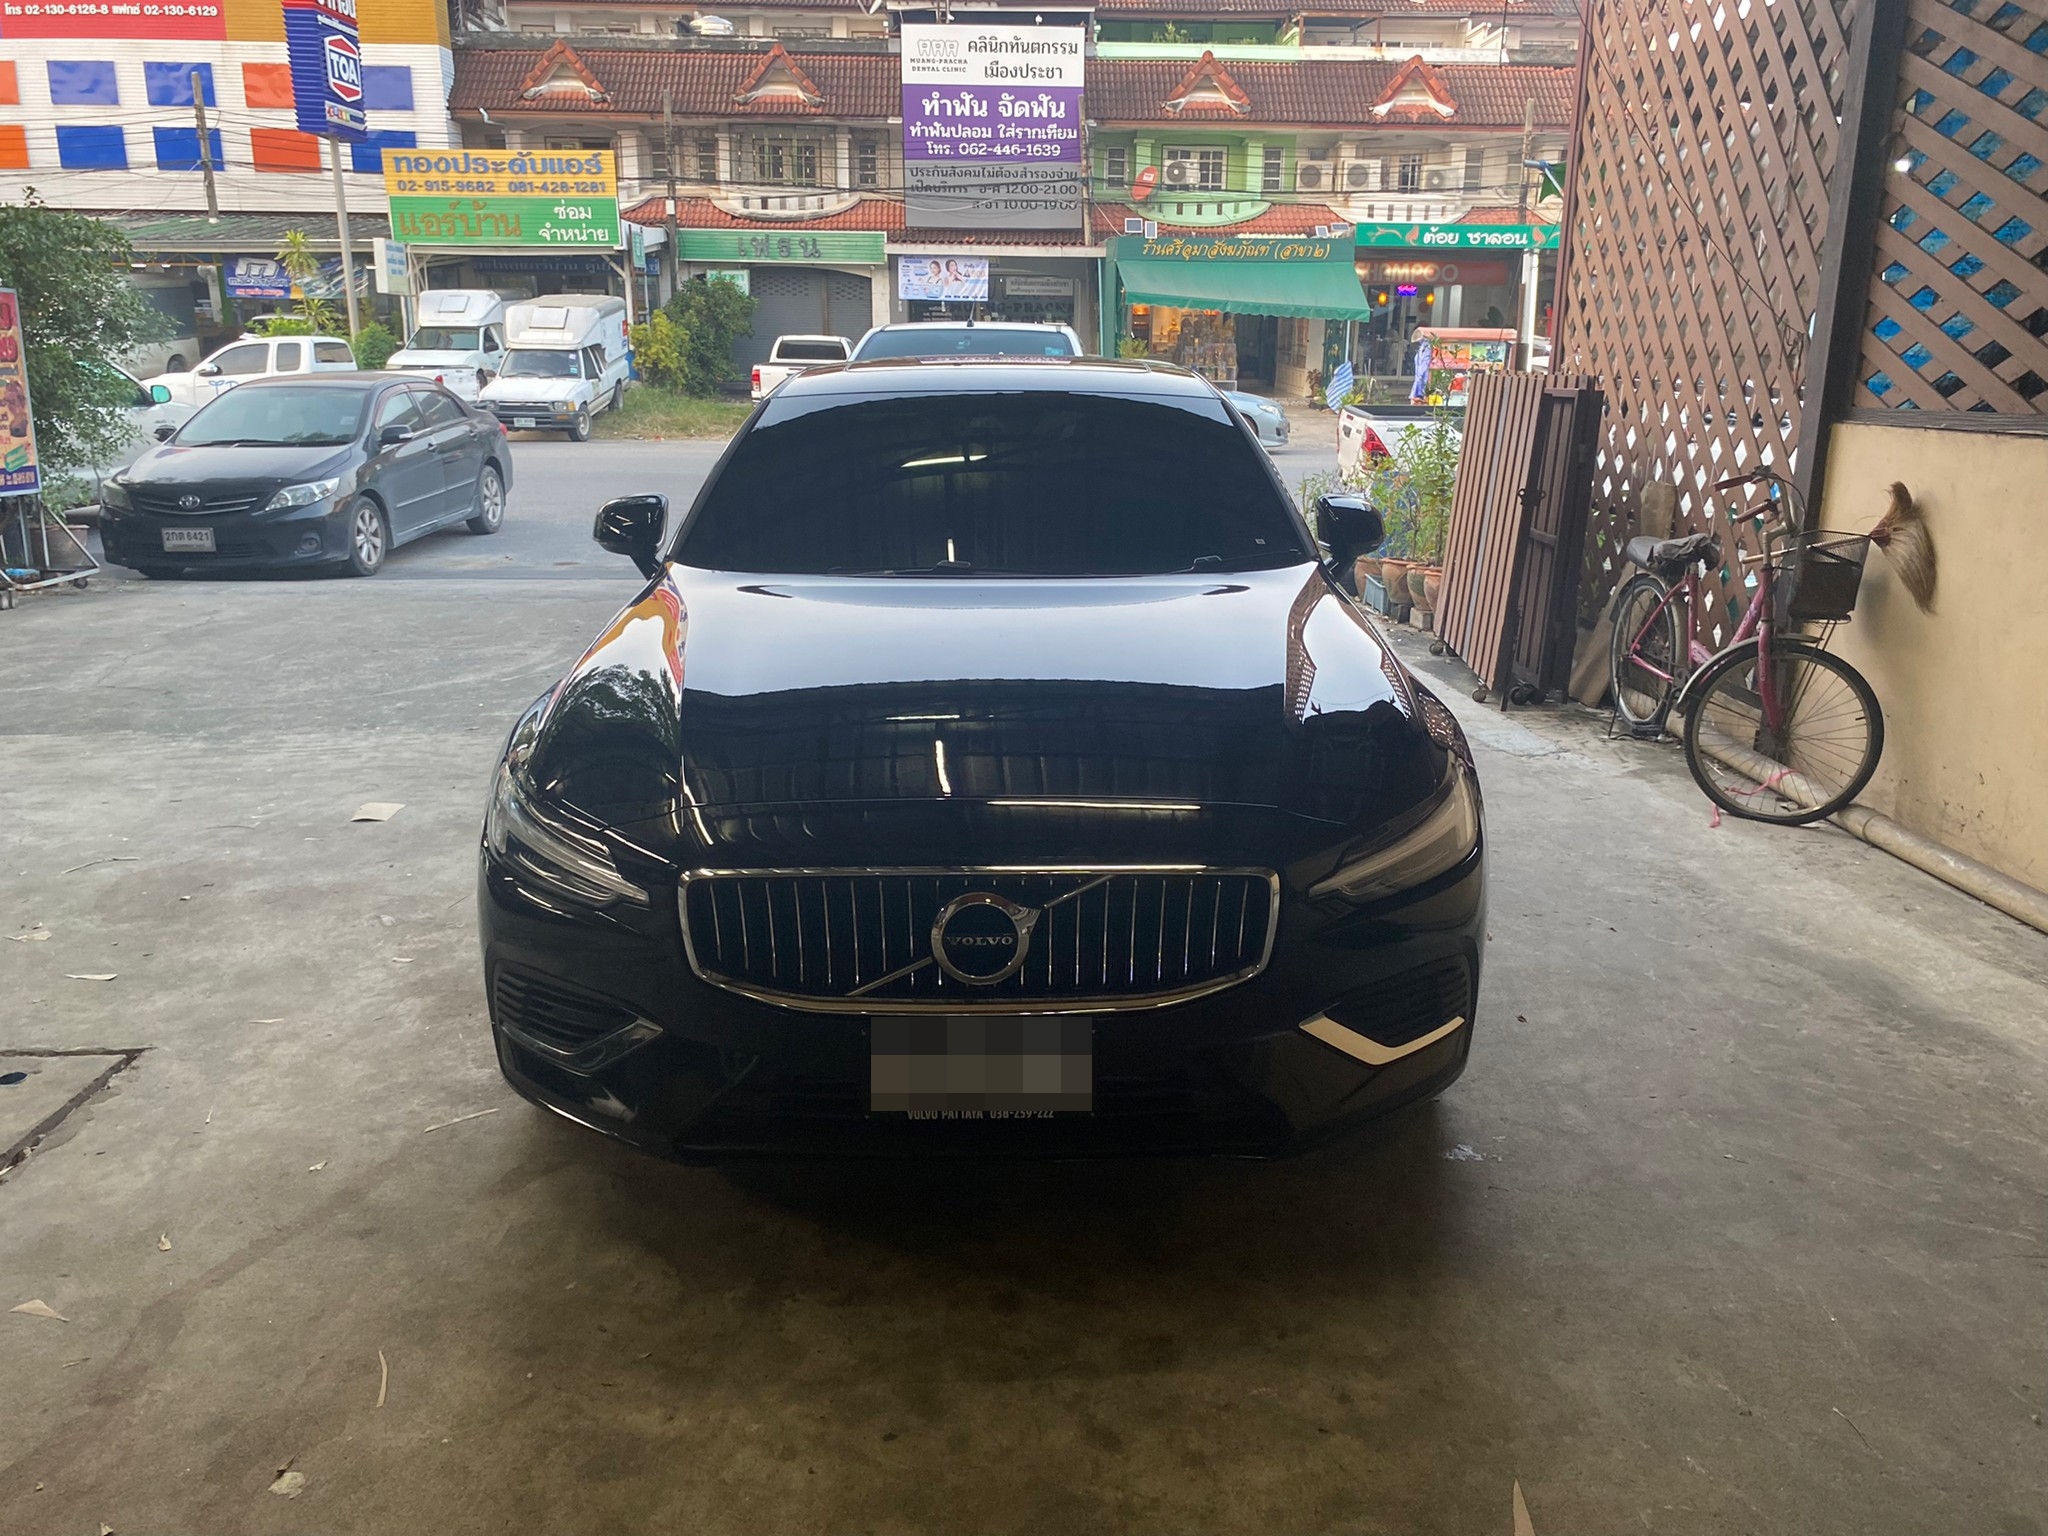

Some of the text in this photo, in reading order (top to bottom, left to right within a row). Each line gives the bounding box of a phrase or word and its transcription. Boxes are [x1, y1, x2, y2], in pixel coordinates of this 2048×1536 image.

[25, 4, 109, 15] 02-130-6126-8
[143, 5, 218, 16] 02-130-6129
[967, 35, 1078, 55] คลินิกทันตกรรม
[330, 51, 359, 85] TOA
[909, 57, 968, 65] MUANG-PRACHA
[984, 61, 1063, 79] เมืองประชา
[922, 91, 1066, 118] ทำฟัน จัดฟัน
[909, 122, 1078, 140] ทำฟันปลอม ใส่รากเทียม
[926, 141, 1061, 157] โทร. 062-446-1639
[393, 151, 603, 176] ทองประดับแอร์
[397, 180, 607, 194] 02-915-9682 081-428-1281
[1005, 183, 1078, 195] 12.00-21.00
[400, 200, 522, 237] แอร์บ้าน
[553, 199, 592, 220] ซ่อม
[538, 221, 610, 242] จำหน่าย
[1423, 226, 1528, 245] ต้อย ซาลอน
[1354, 263, 1459, 282] SHAMPOO
[187, 531, 209, 541] 6421
[946, 936, 1014, 946] VOLVO
[907, 1111, 937, 1120] VOLVO
